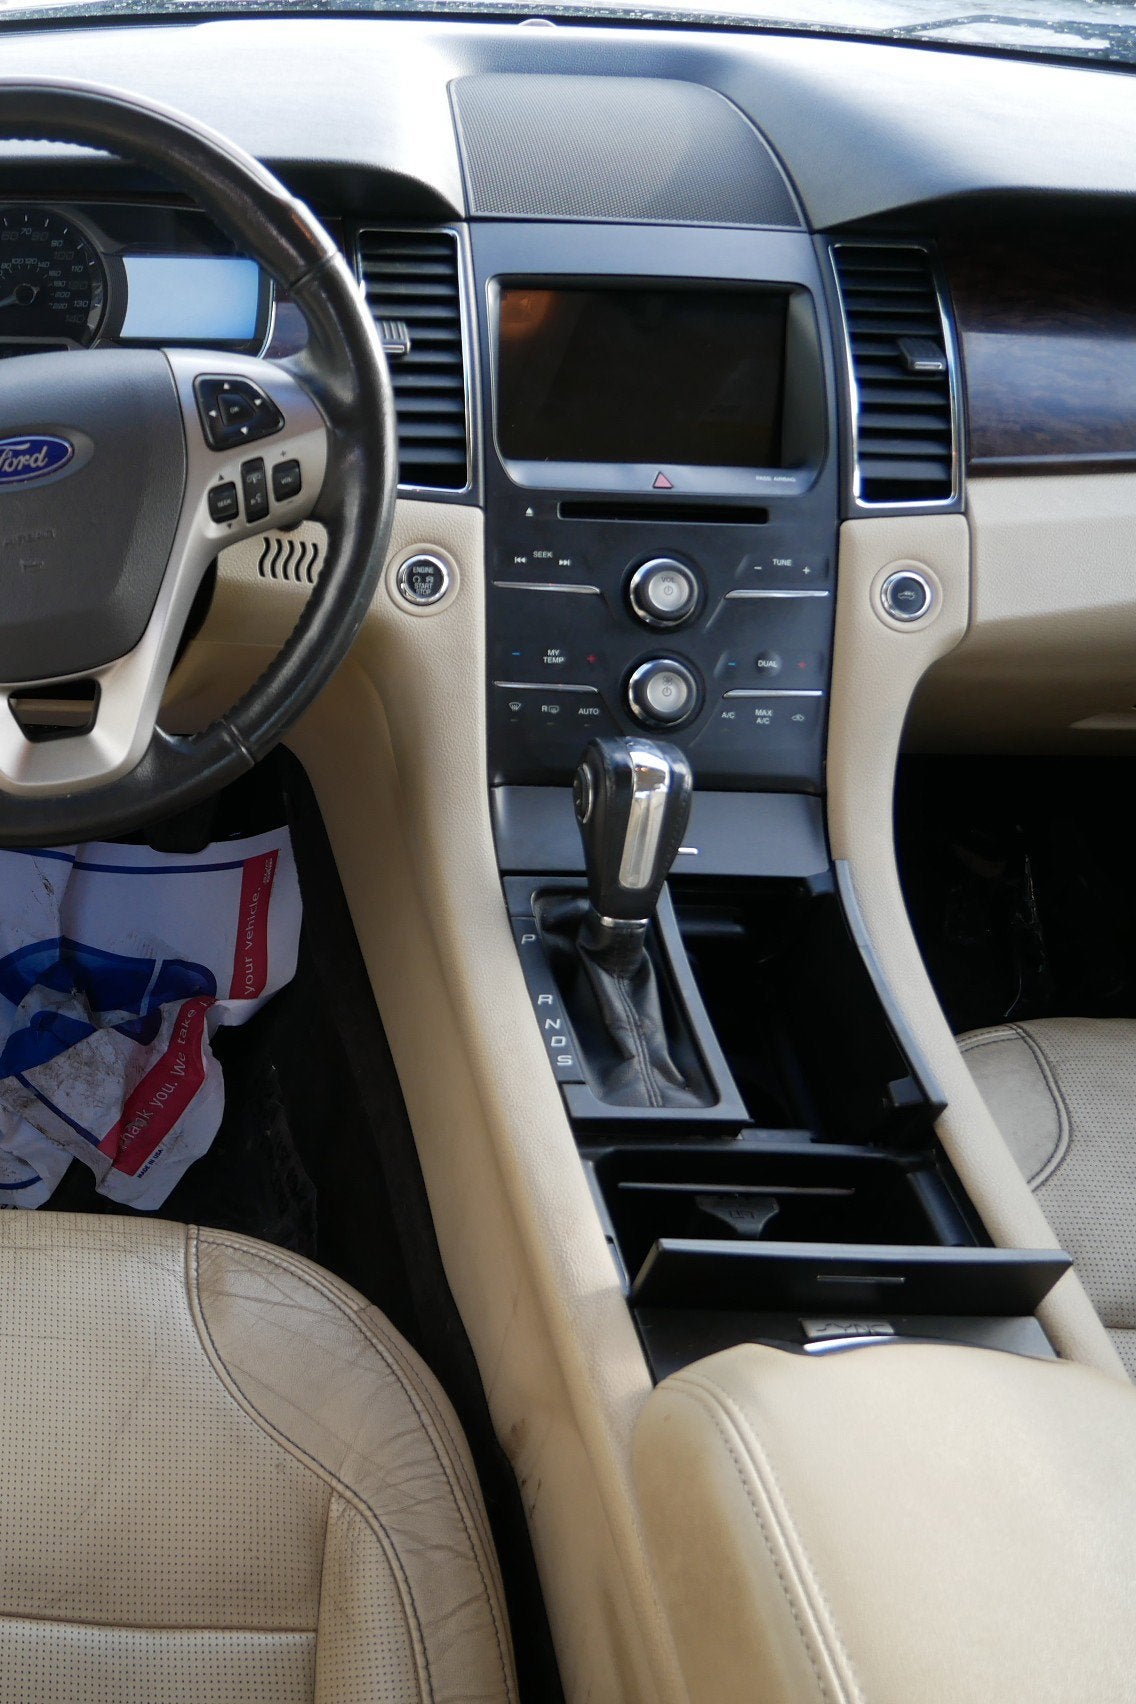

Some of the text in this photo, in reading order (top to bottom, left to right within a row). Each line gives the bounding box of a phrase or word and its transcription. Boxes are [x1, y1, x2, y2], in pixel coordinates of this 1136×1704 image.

[772, 558, 793, 567] TUNE
[412, 566, 434, 574] ENGINE
[543, 656, 564, 664] TEMP
[757, 660, 778, 668] DUAL
[721, 712, 735, 720] A/C
[755, 709, 772, 717] MAX
[756, 717, 770, 725] A/C
[244, 887, 261, 995] your vehicle.
[521, 934, 536, 944] P
[538, 994, 553, 1005] R
[176, 1009, 196, 1044] take
[545, 1018, 561, 1029] N
[551, 1036, 566, 1047] D
[170, 1052, 186, 1076] We
[557, 1055, 573, 1066] S
[149, 1081, 178, 1108] you.
[137, 1165, 150, 1178] MADE
[153, 1149, 164, 1159] USA
